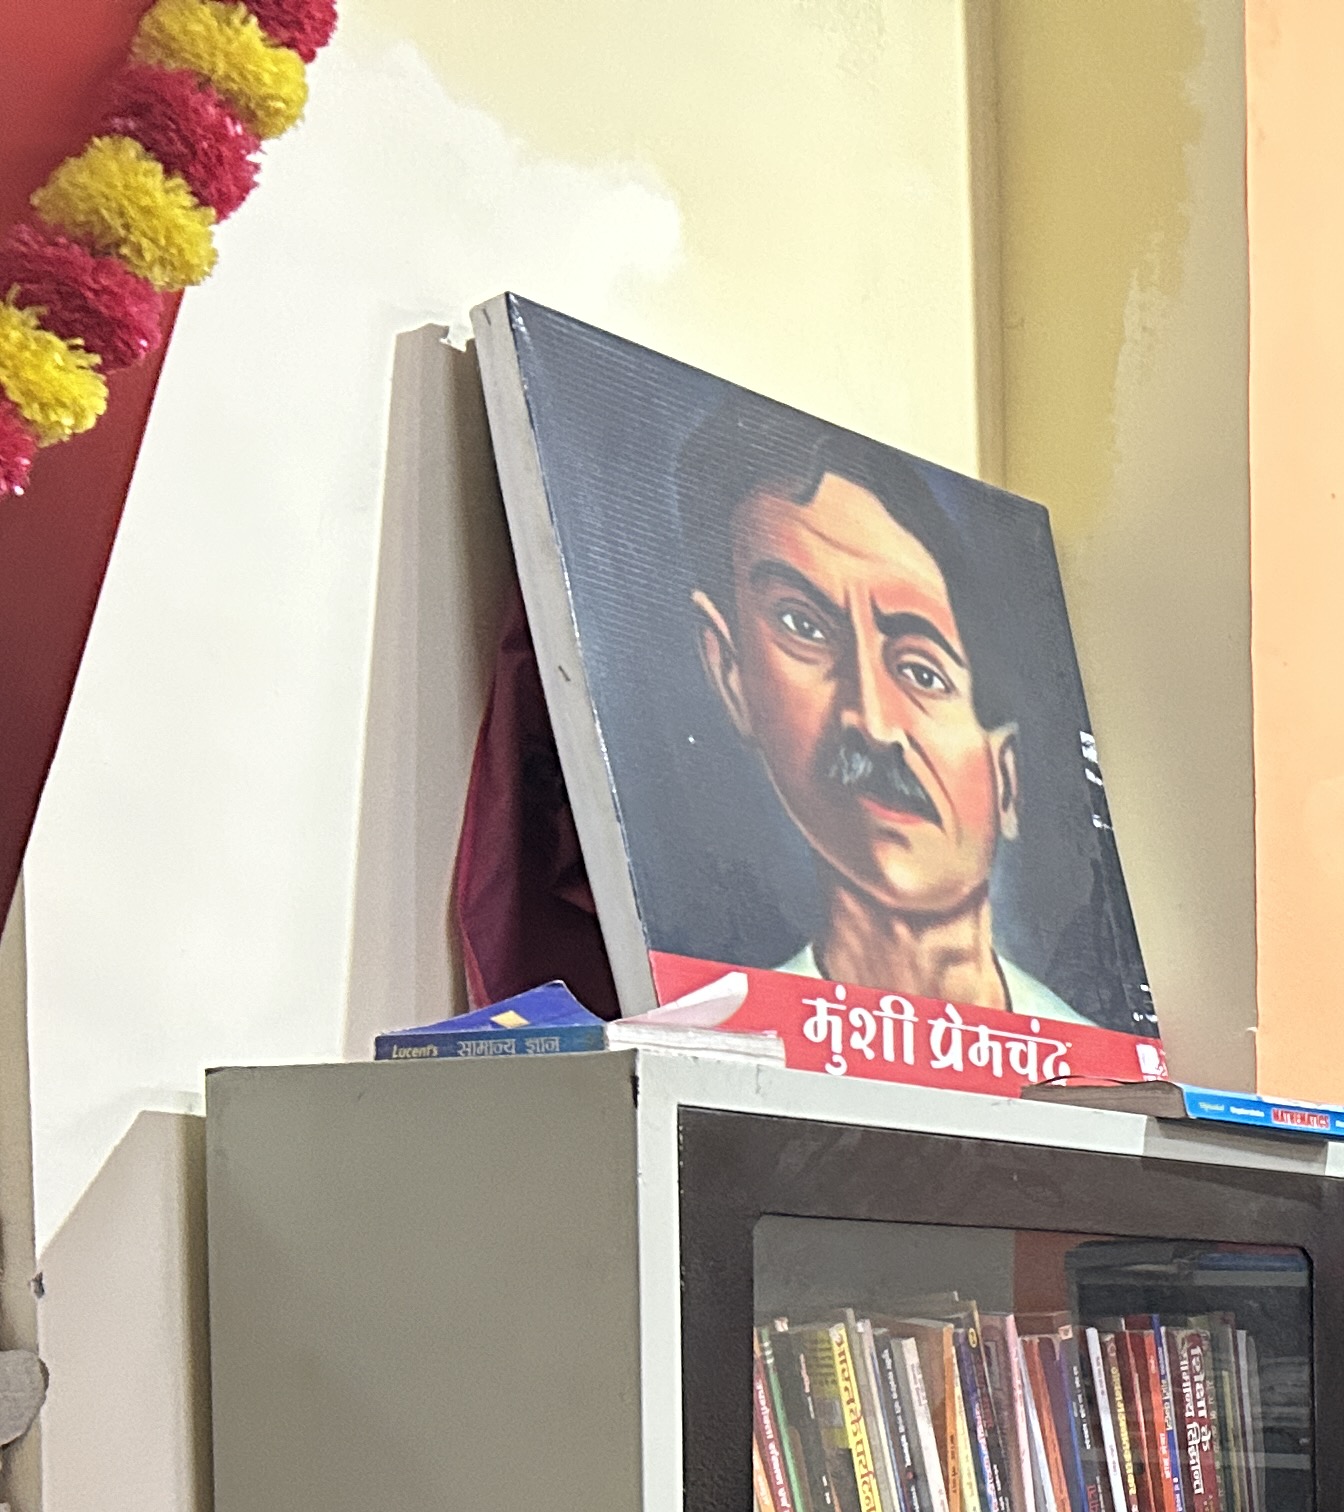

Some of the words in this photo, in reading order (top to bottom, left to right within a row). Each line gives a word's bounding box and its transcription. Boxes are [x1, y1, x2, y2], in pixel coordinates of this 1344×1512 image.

[392, 1043, 439, 1060] Lucent's
[457, 1038, 517, 1058] सामान्य
[525, 1036, 560, 1055] ज्ञान
[802, 984, 918, 1076] मुंशी
[928, 1003, 1073, 1086] प्रेमचंद
[1273, 1109, 1330, 1129] MATHEMATICS
[1190, 1345, 1208, 1418] शिक्षा
[1199, 1424, 1212, 1452] के
